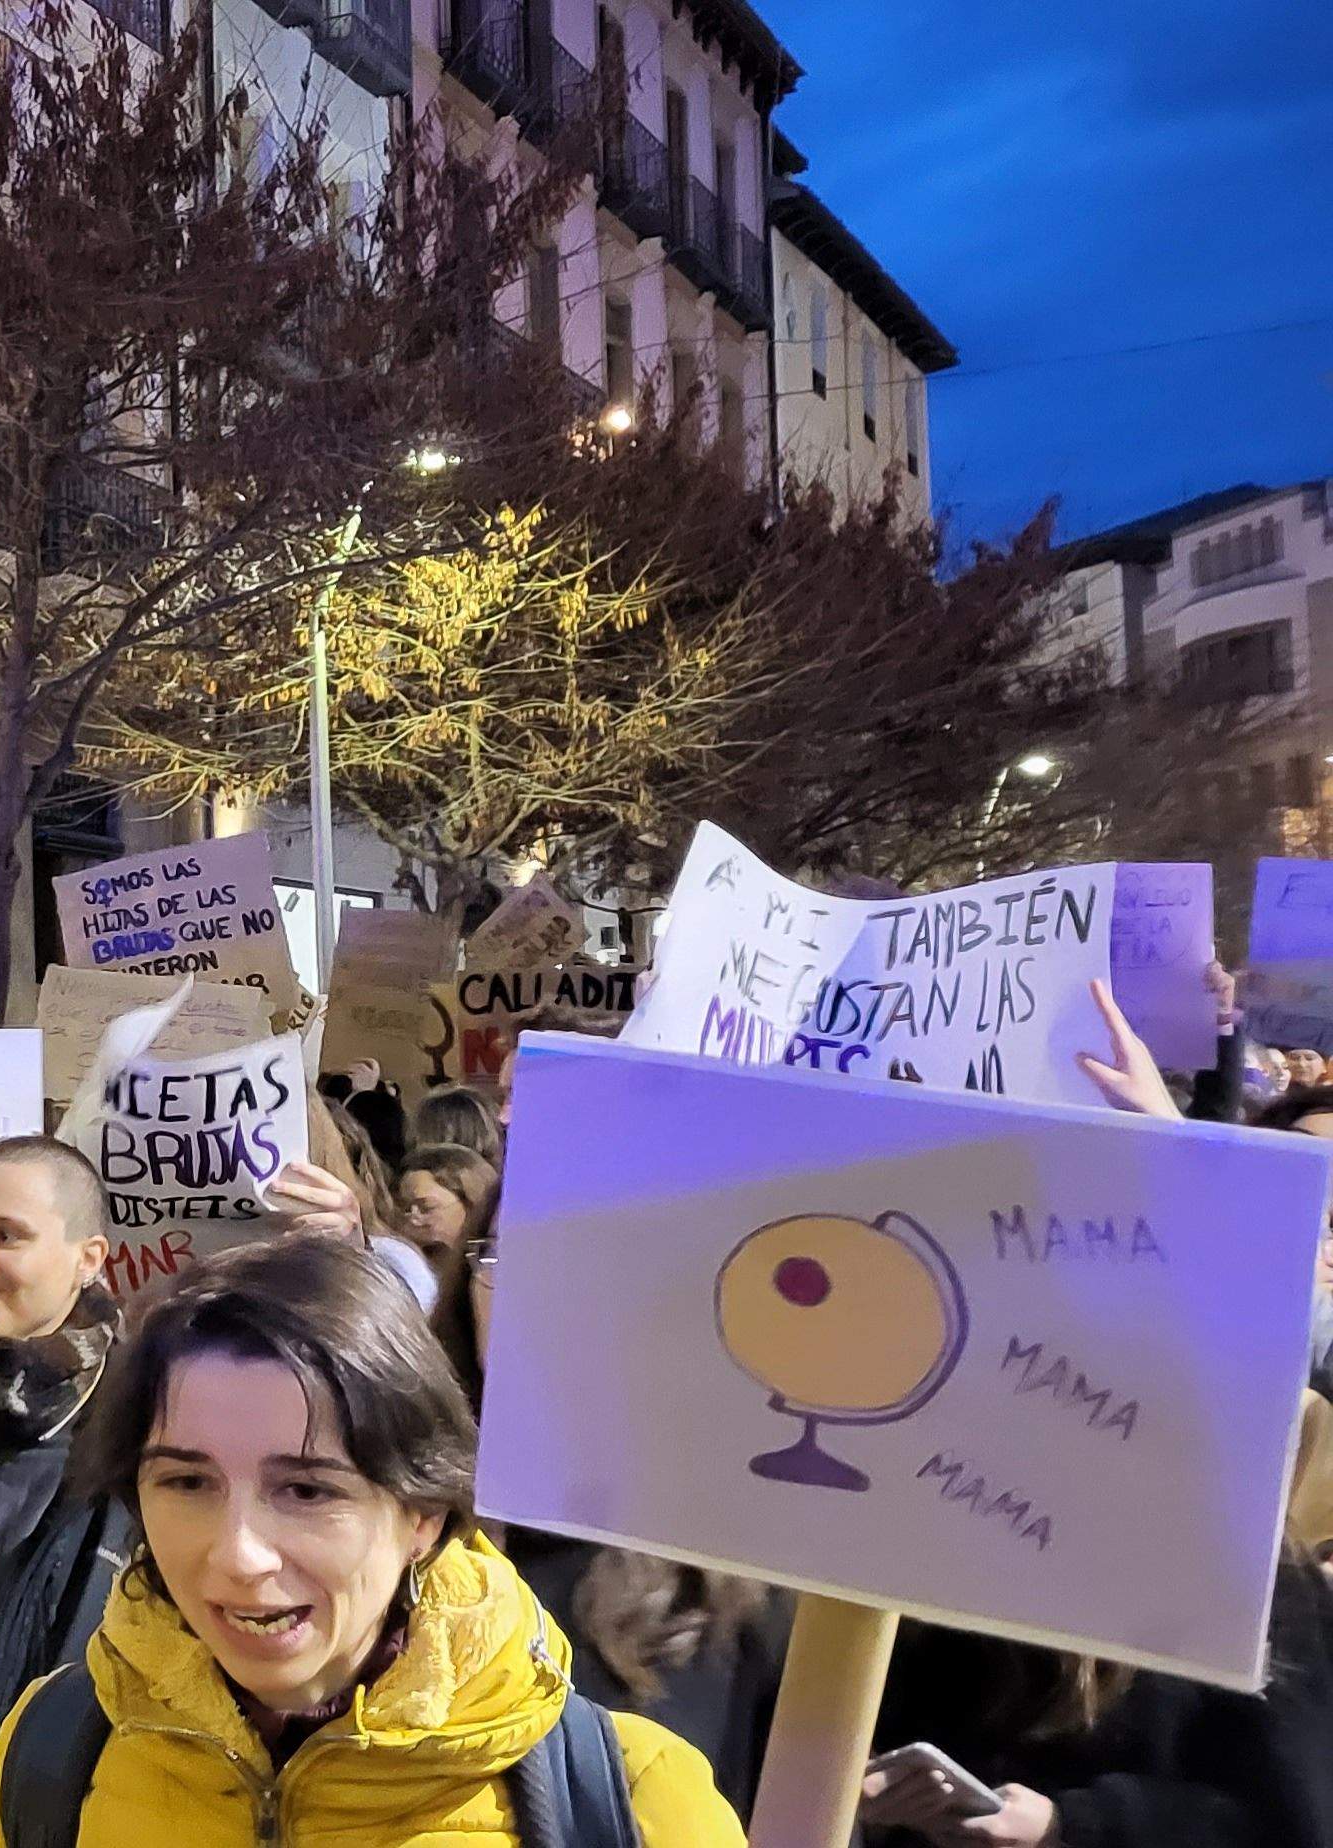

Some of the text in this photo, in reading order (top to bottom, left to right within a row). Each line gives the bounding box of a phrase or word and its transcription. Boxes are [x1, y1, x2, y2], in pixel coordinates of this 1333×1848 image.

[161, 857, 201, 880] LAS
[82, 885, 237, 938] HIJAS DE LAS
[92, 908, 275, 964] BRUJAS QUE NO
[867, 876, 1097, 970] TAMBIÉN
[459, 972, 636, 1015] CALLADIT
[976, 957, 1036, 1036] LAS
[101, 1119, 281, 1189] BRUJAS
[1000, 1335, 1140, 1442] MAMA
[917, 1453, 1051, 1552] MAMA
